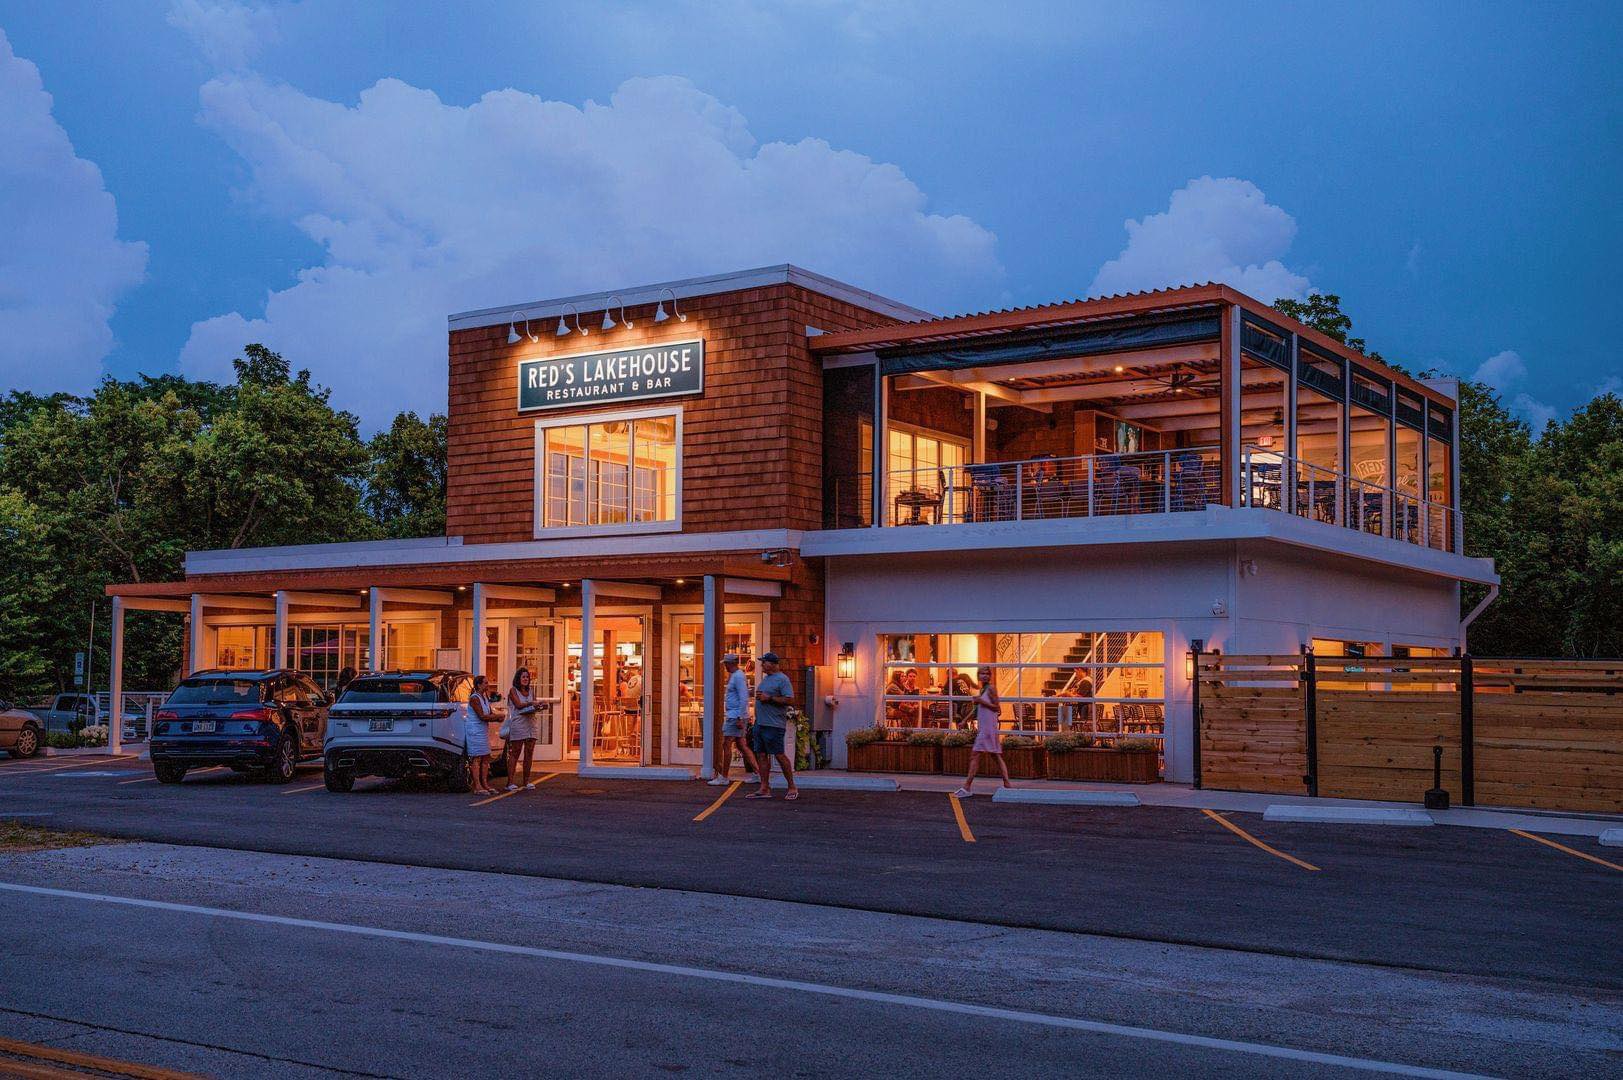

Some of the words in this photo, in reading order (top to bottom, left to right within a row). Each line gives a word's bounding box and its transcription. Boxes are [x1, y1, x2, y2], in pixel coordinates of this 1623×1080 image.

[528, 363, 575, 388] RED'S
[583, 349, 691, 382] LAKEHOUSE
[546, 382, 625, 400] RESTAURANT
[631, 381, 639, 391] &
[646, 377, 672, 389] BAR
[1260, 437, 1273, 446] EXIT
